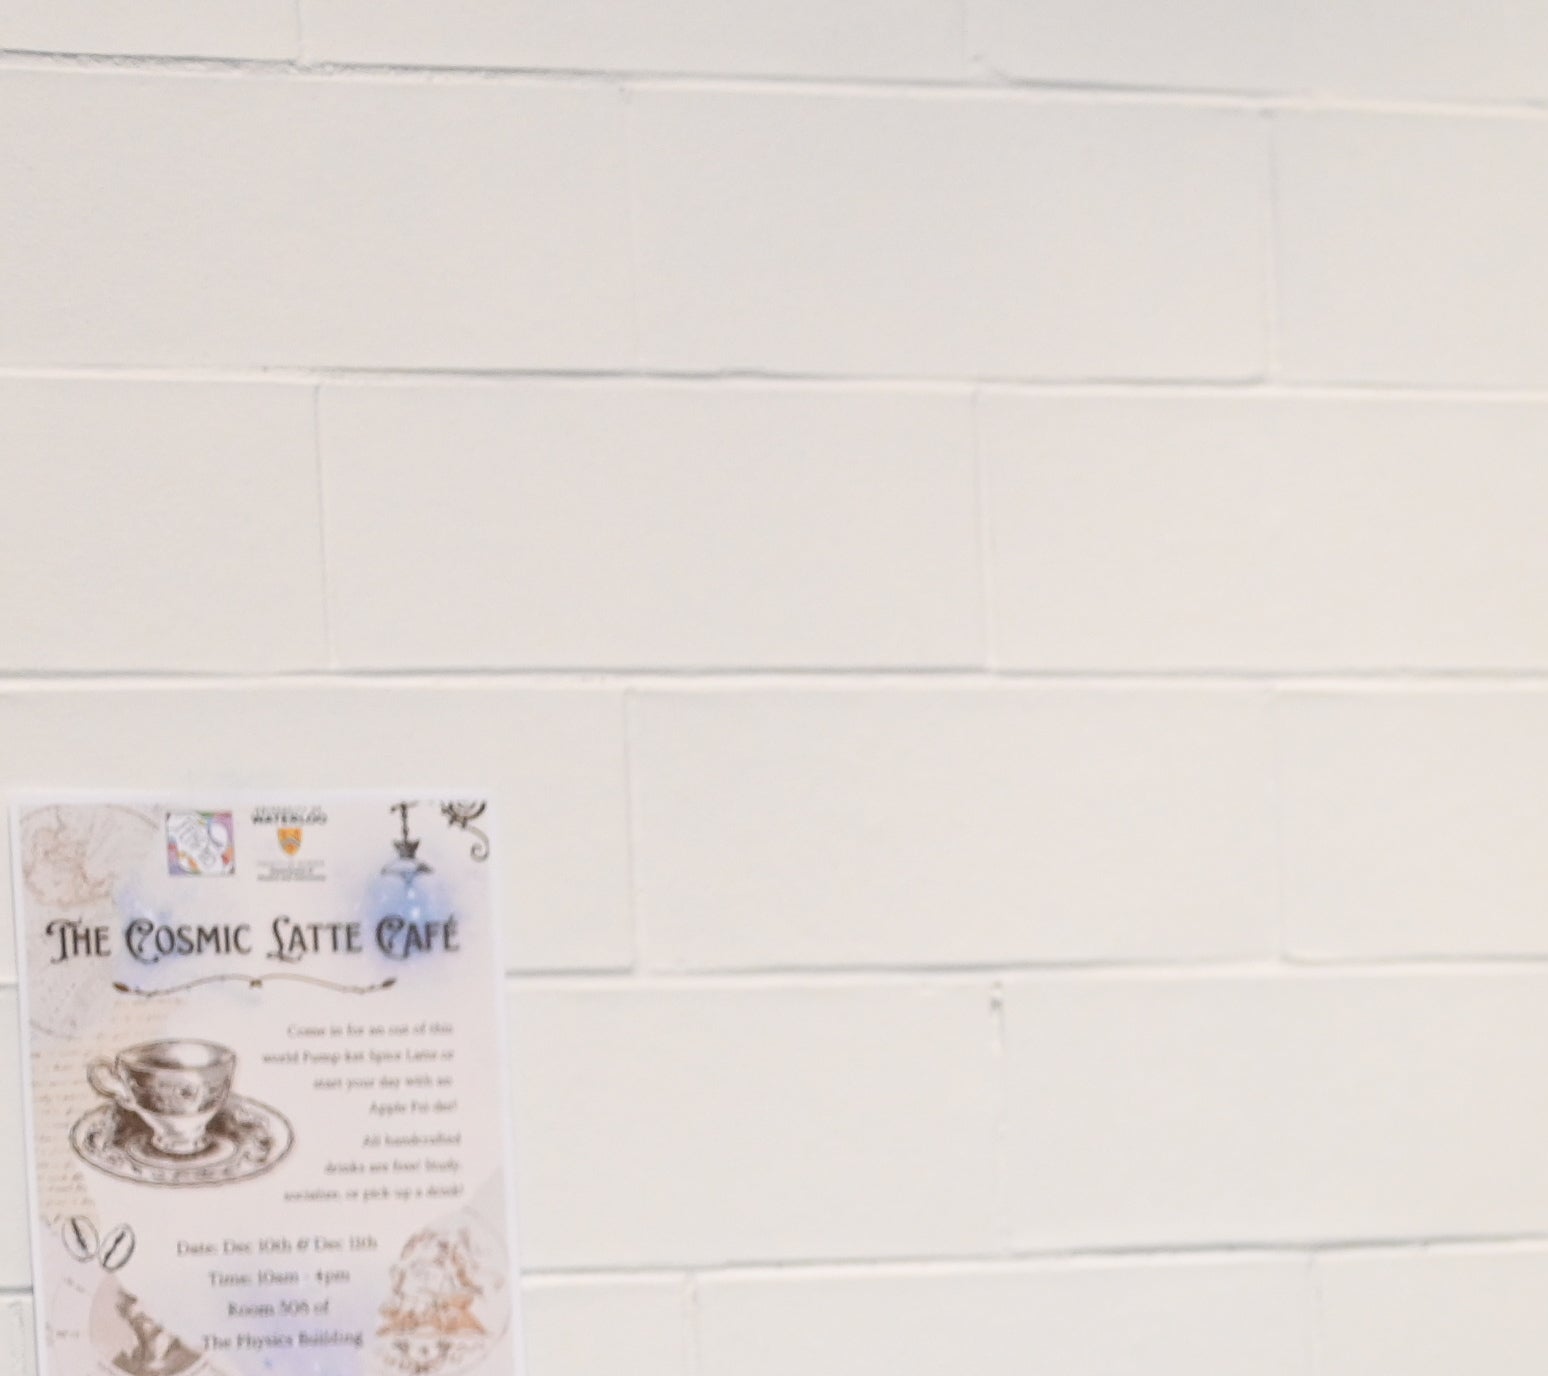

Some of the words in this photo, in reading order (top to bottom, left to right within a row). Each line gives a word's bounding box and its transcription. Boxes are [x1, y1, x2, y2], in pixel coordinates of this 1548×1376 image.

[46, 917, 112, 965] THE
[125, 917, 252, 965] COSMIC
[266, 914, 363, 964] LATTE
